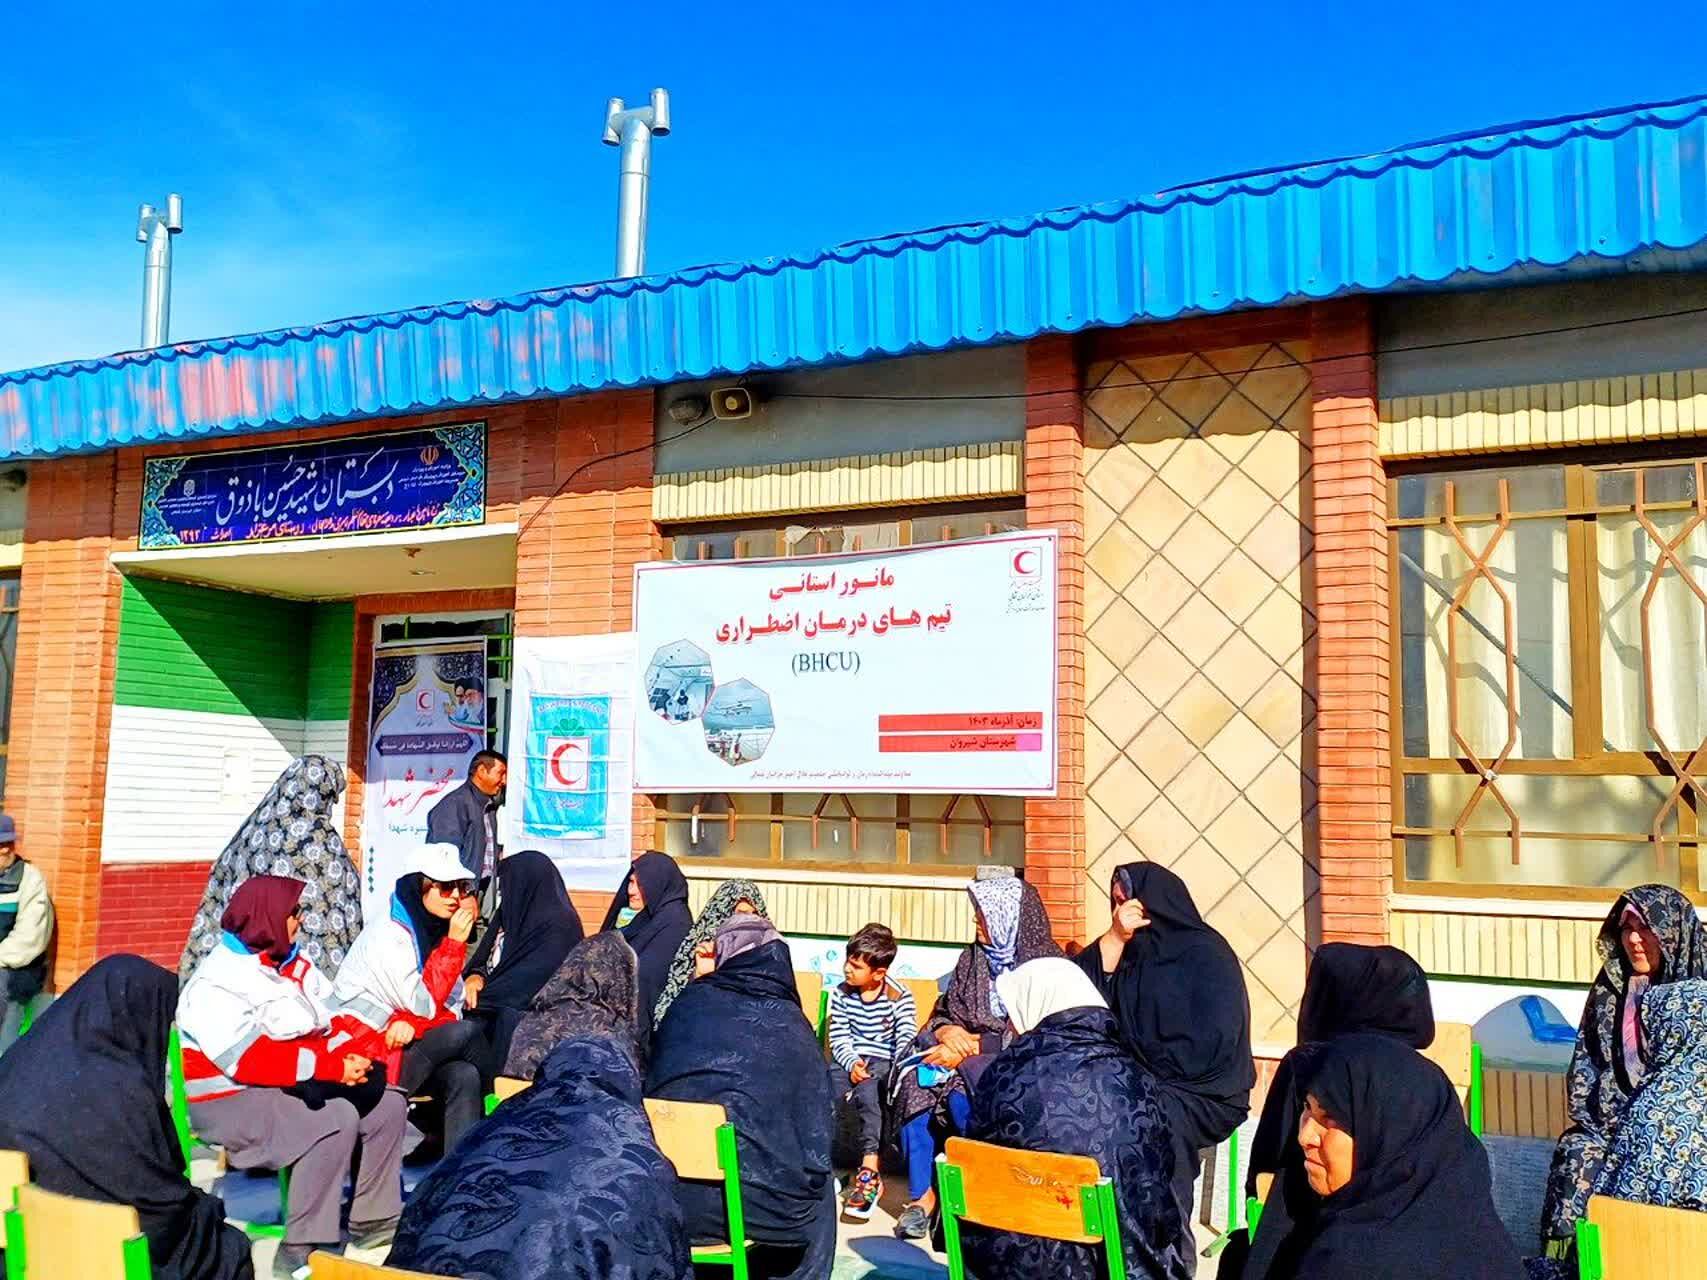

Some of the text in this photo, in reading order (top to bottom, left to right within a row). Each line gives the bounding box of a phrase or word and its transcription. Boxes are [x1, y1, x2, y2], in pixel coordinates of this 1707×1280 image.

[262, 454, 307, 522] حسین
[282, 460, 319, 514] شهید
[313, 446, 400, 512] دبستان
[768, 567, 896, 600] مانور استانی
[715, 602, 953, 644] تیم های درمان اضطراری
[790, 651, 862, 676] (BHCU)
[979, 735, 1016, 749] شهرستان
